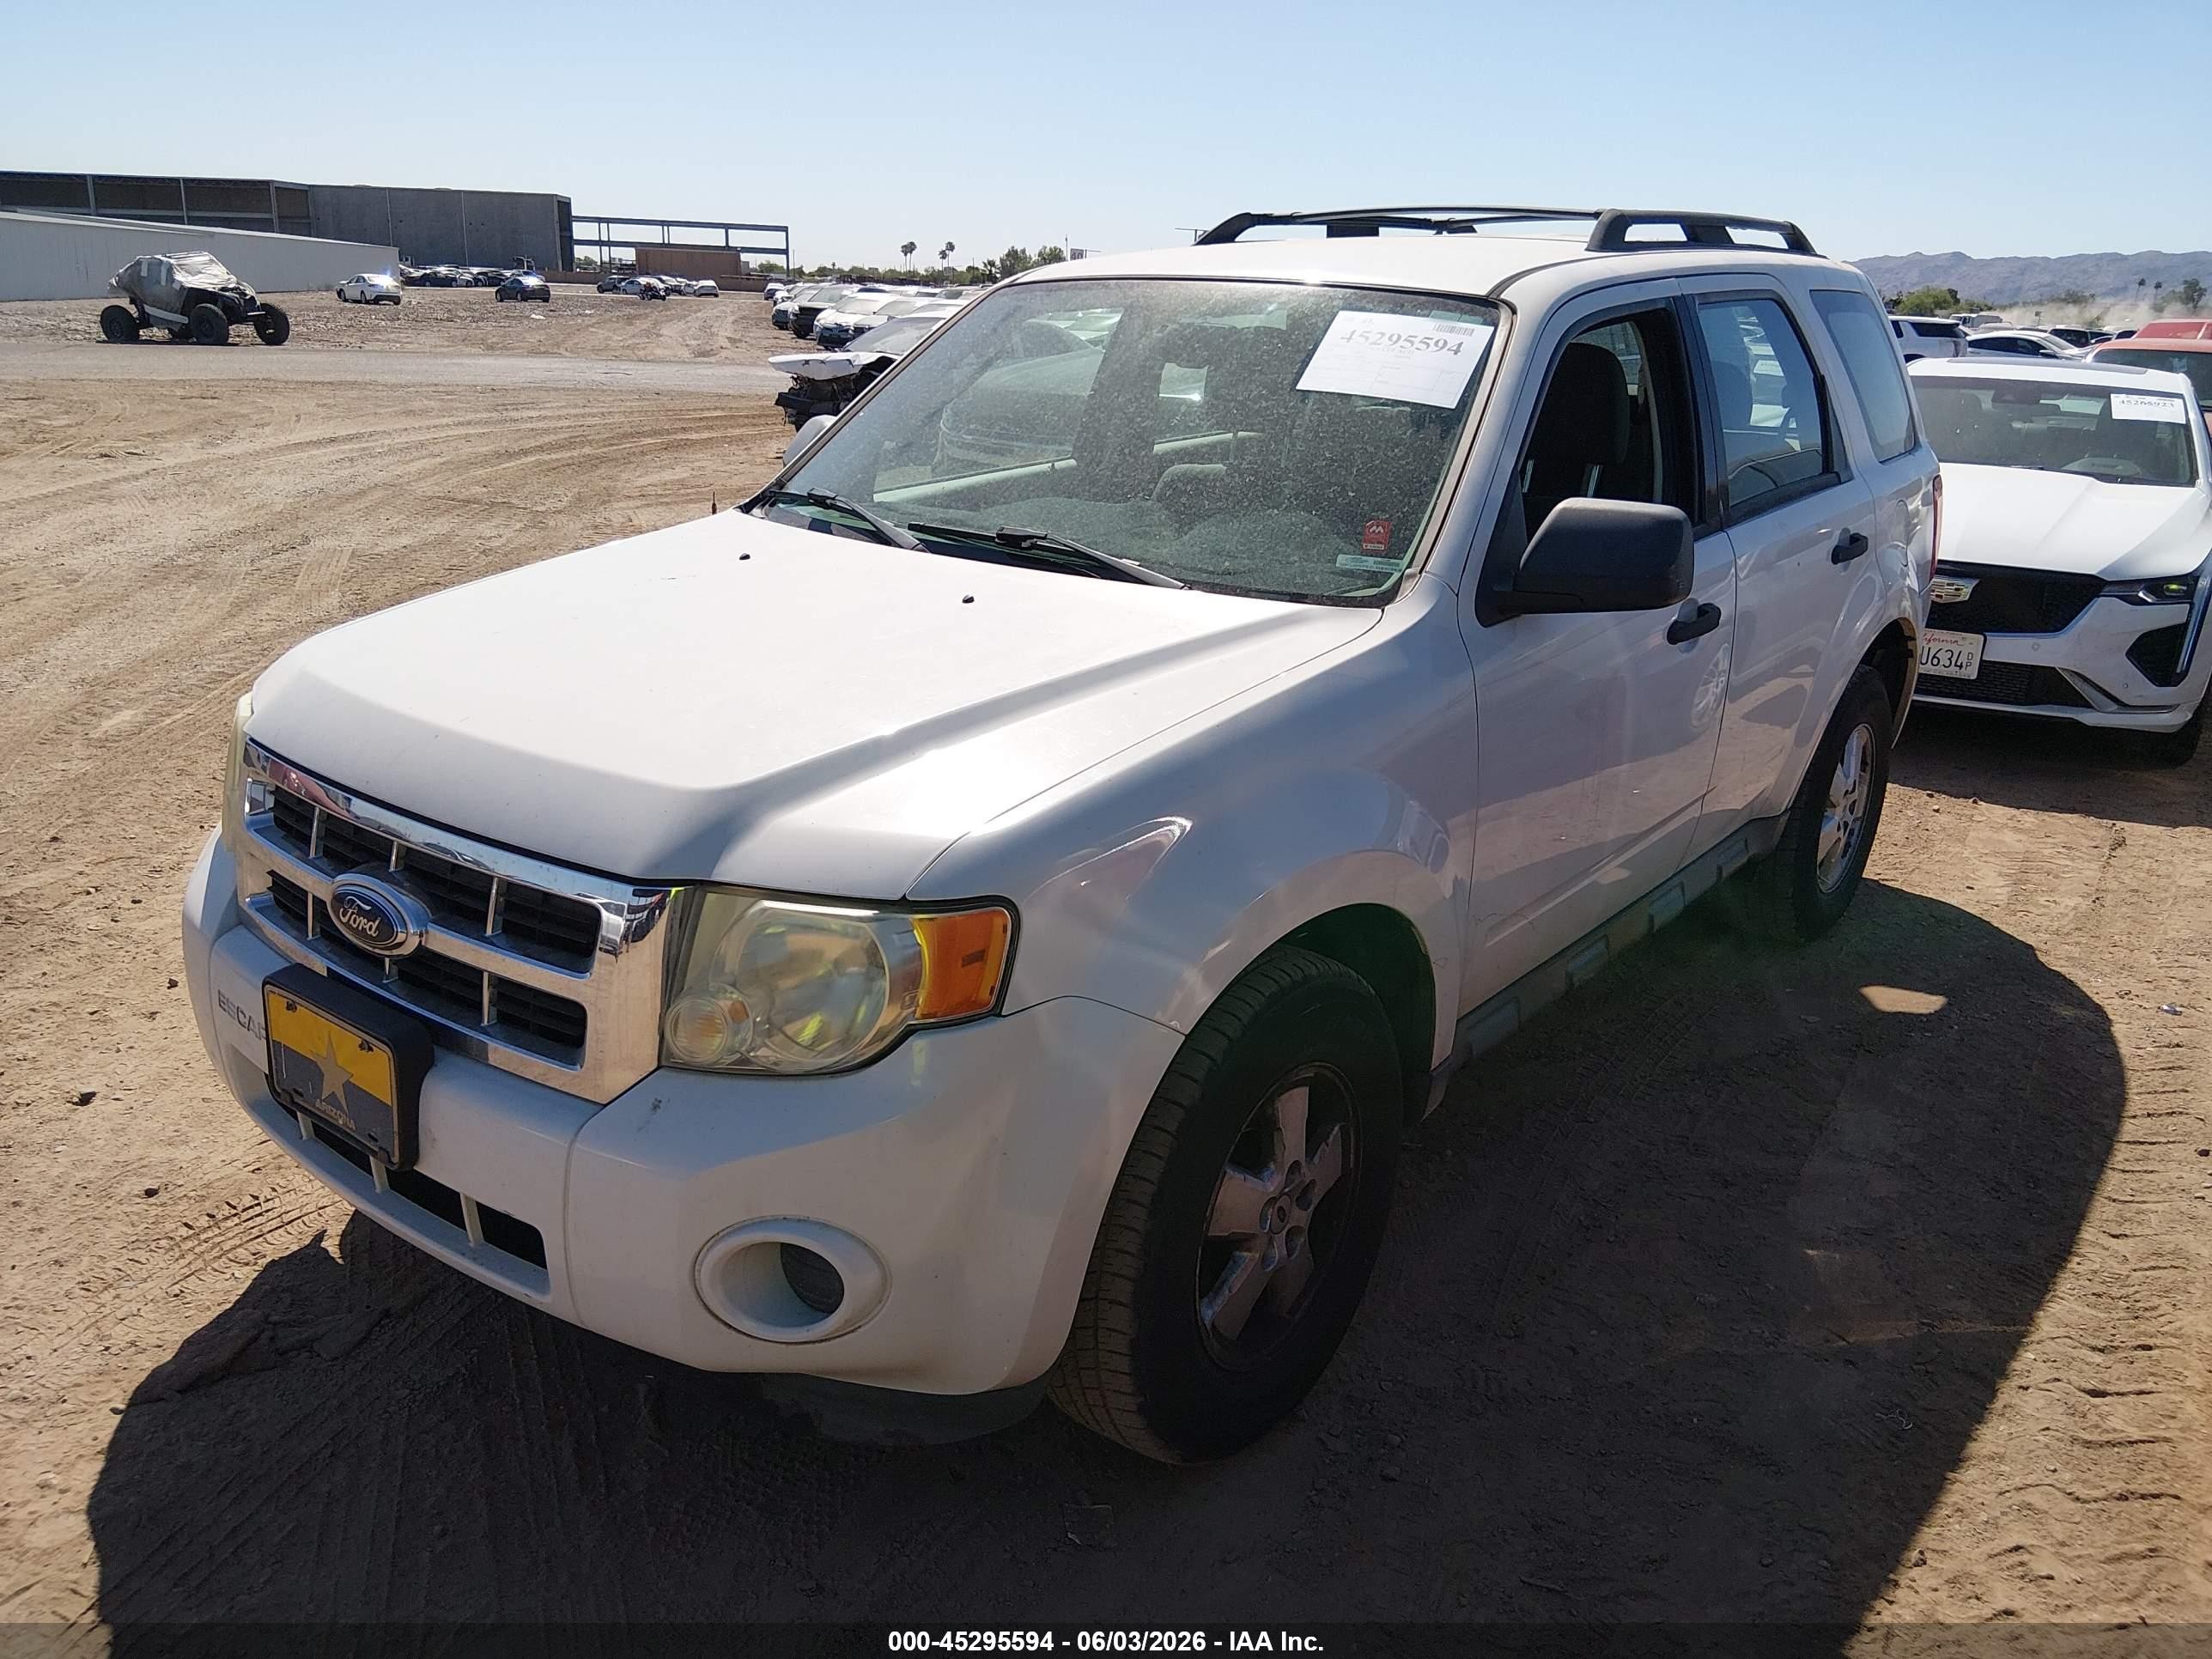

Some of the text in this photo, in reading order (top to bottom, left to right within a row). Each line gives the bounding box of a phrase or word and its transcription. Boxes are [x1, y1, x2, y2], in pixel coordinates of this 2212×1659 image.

[1339, 329, 1464, 356] 45295594
[1919, 646, 1964, 671] U634
[339, 896, 380, 937] Ford
[217, 989, 266, 1041] ESCAP
